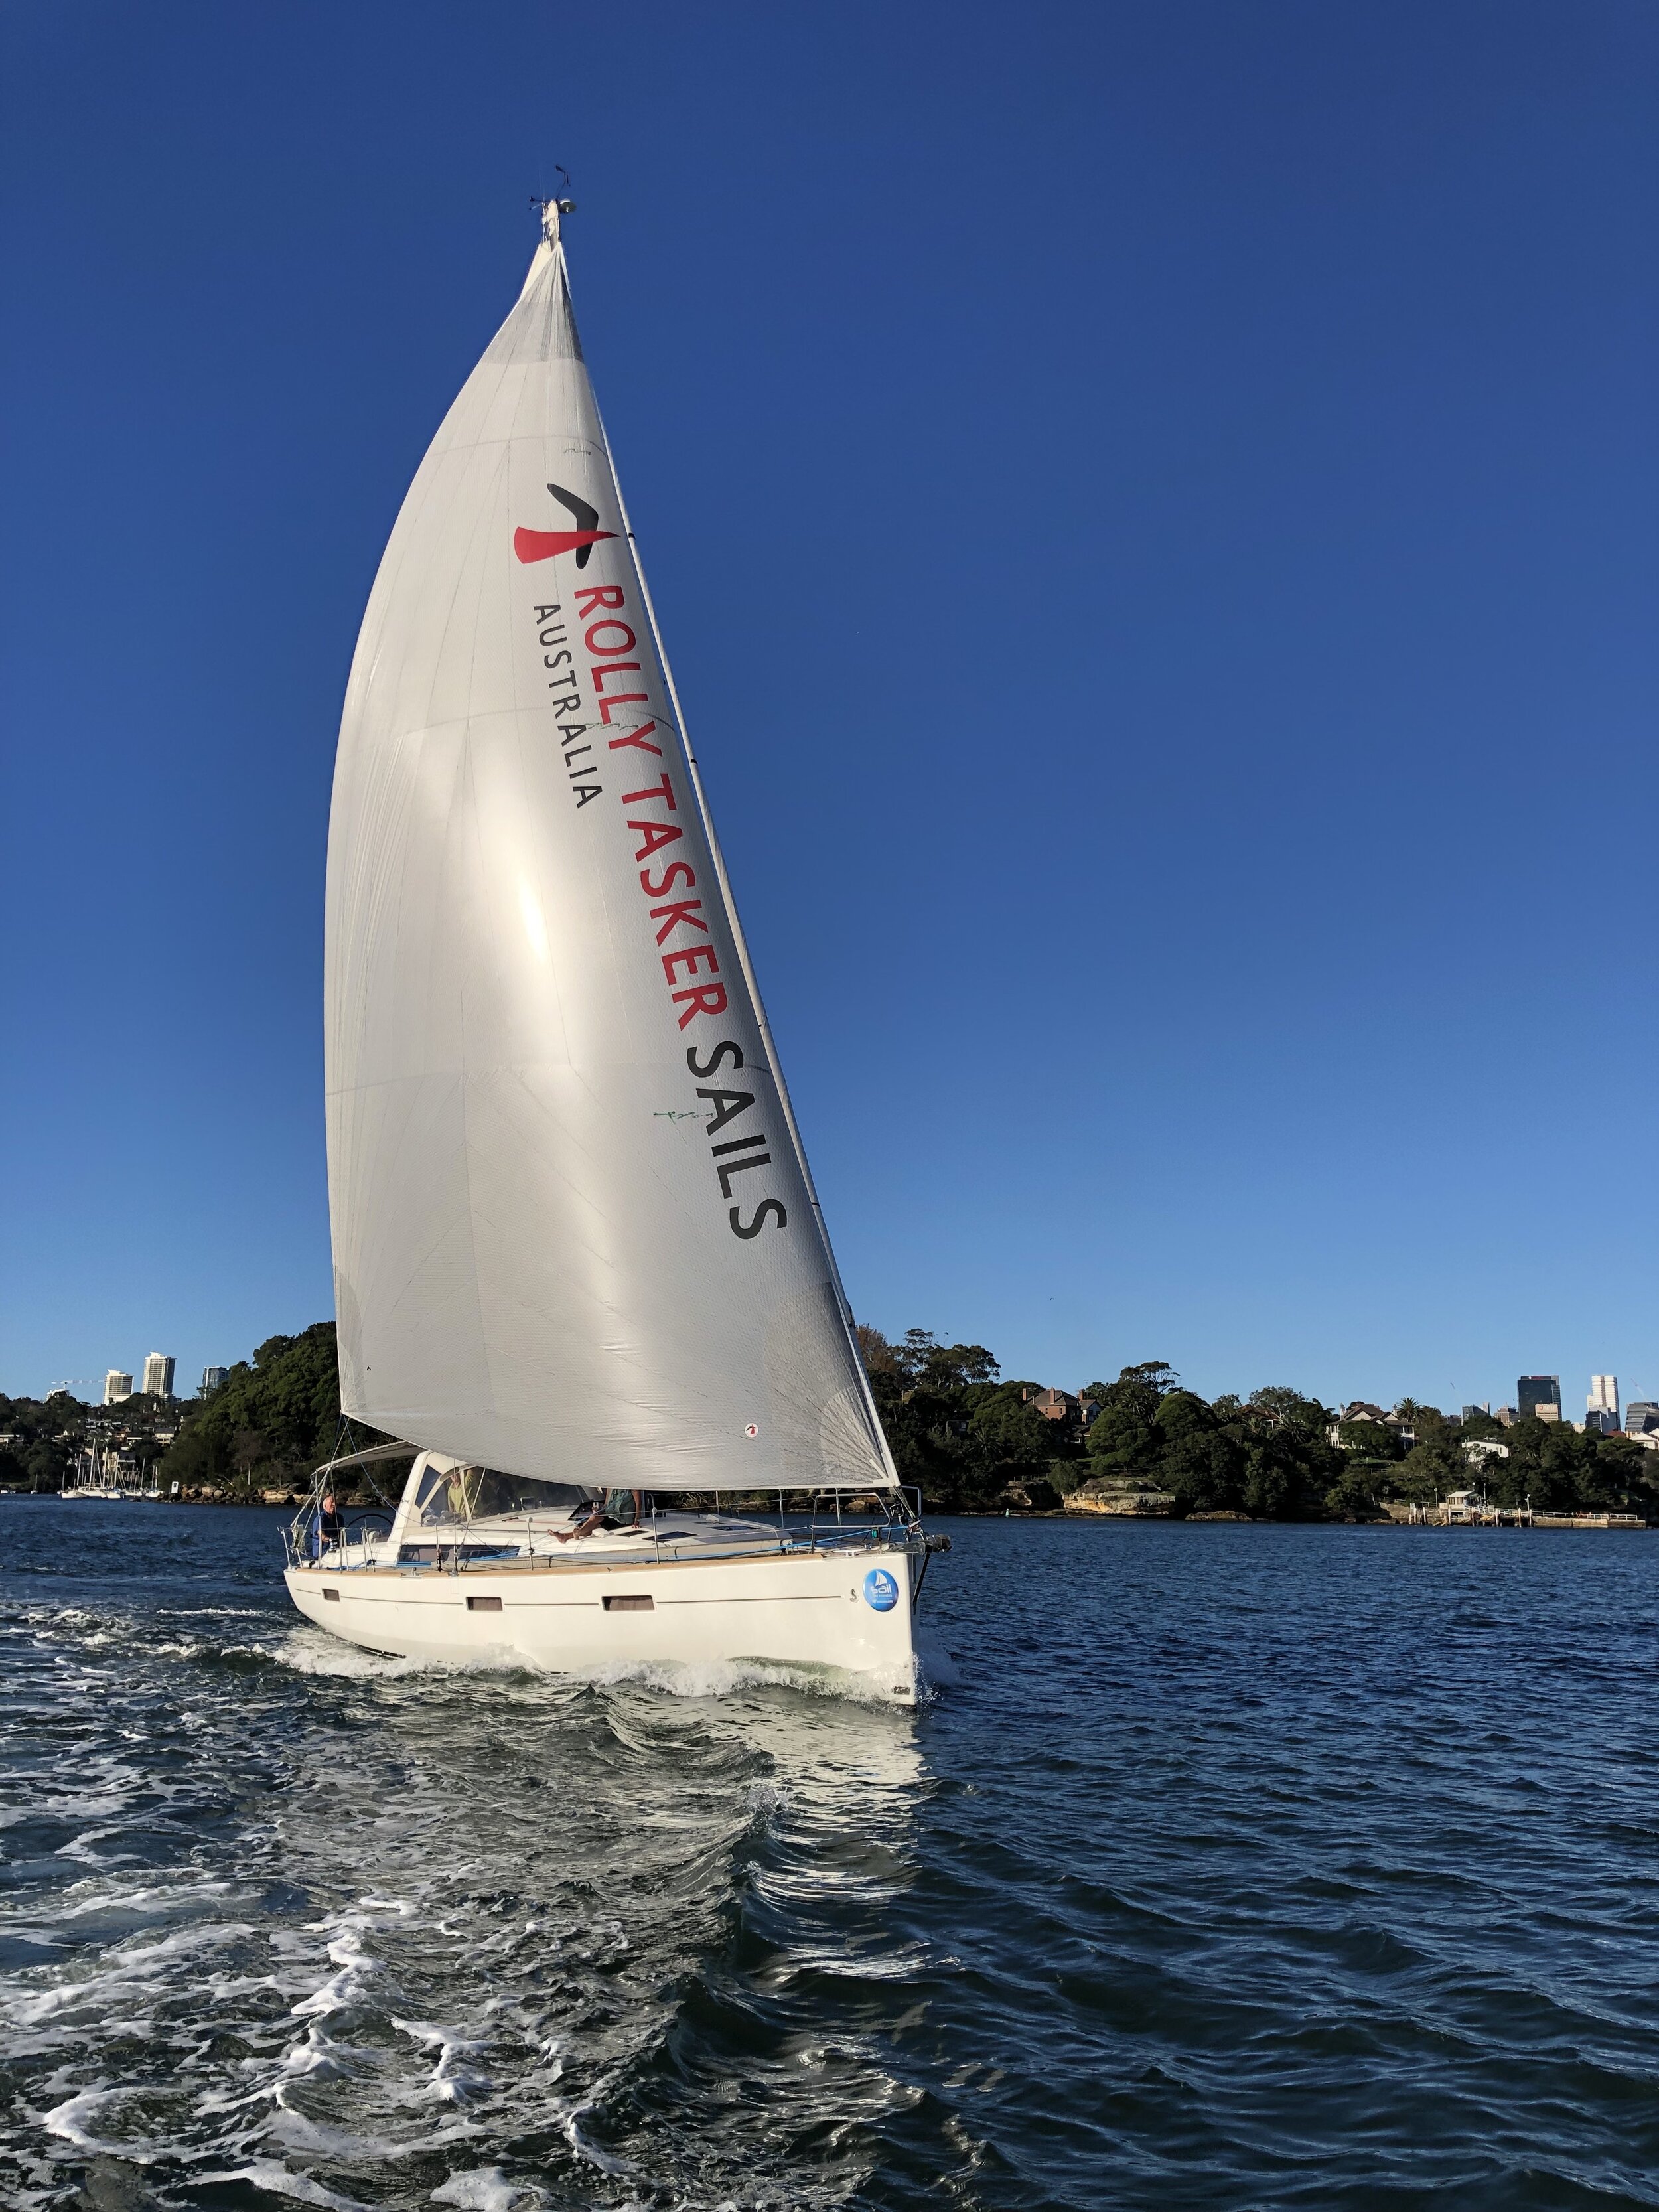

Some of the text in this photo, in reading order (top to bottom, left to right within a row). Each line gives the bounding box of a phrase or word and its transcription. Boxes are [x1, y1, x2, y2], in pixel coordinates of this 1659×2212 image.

[533, 604, 603, 809] AUSTRALIA
[574, 585, 787, 1240] ROLLY TASKER SAILS
